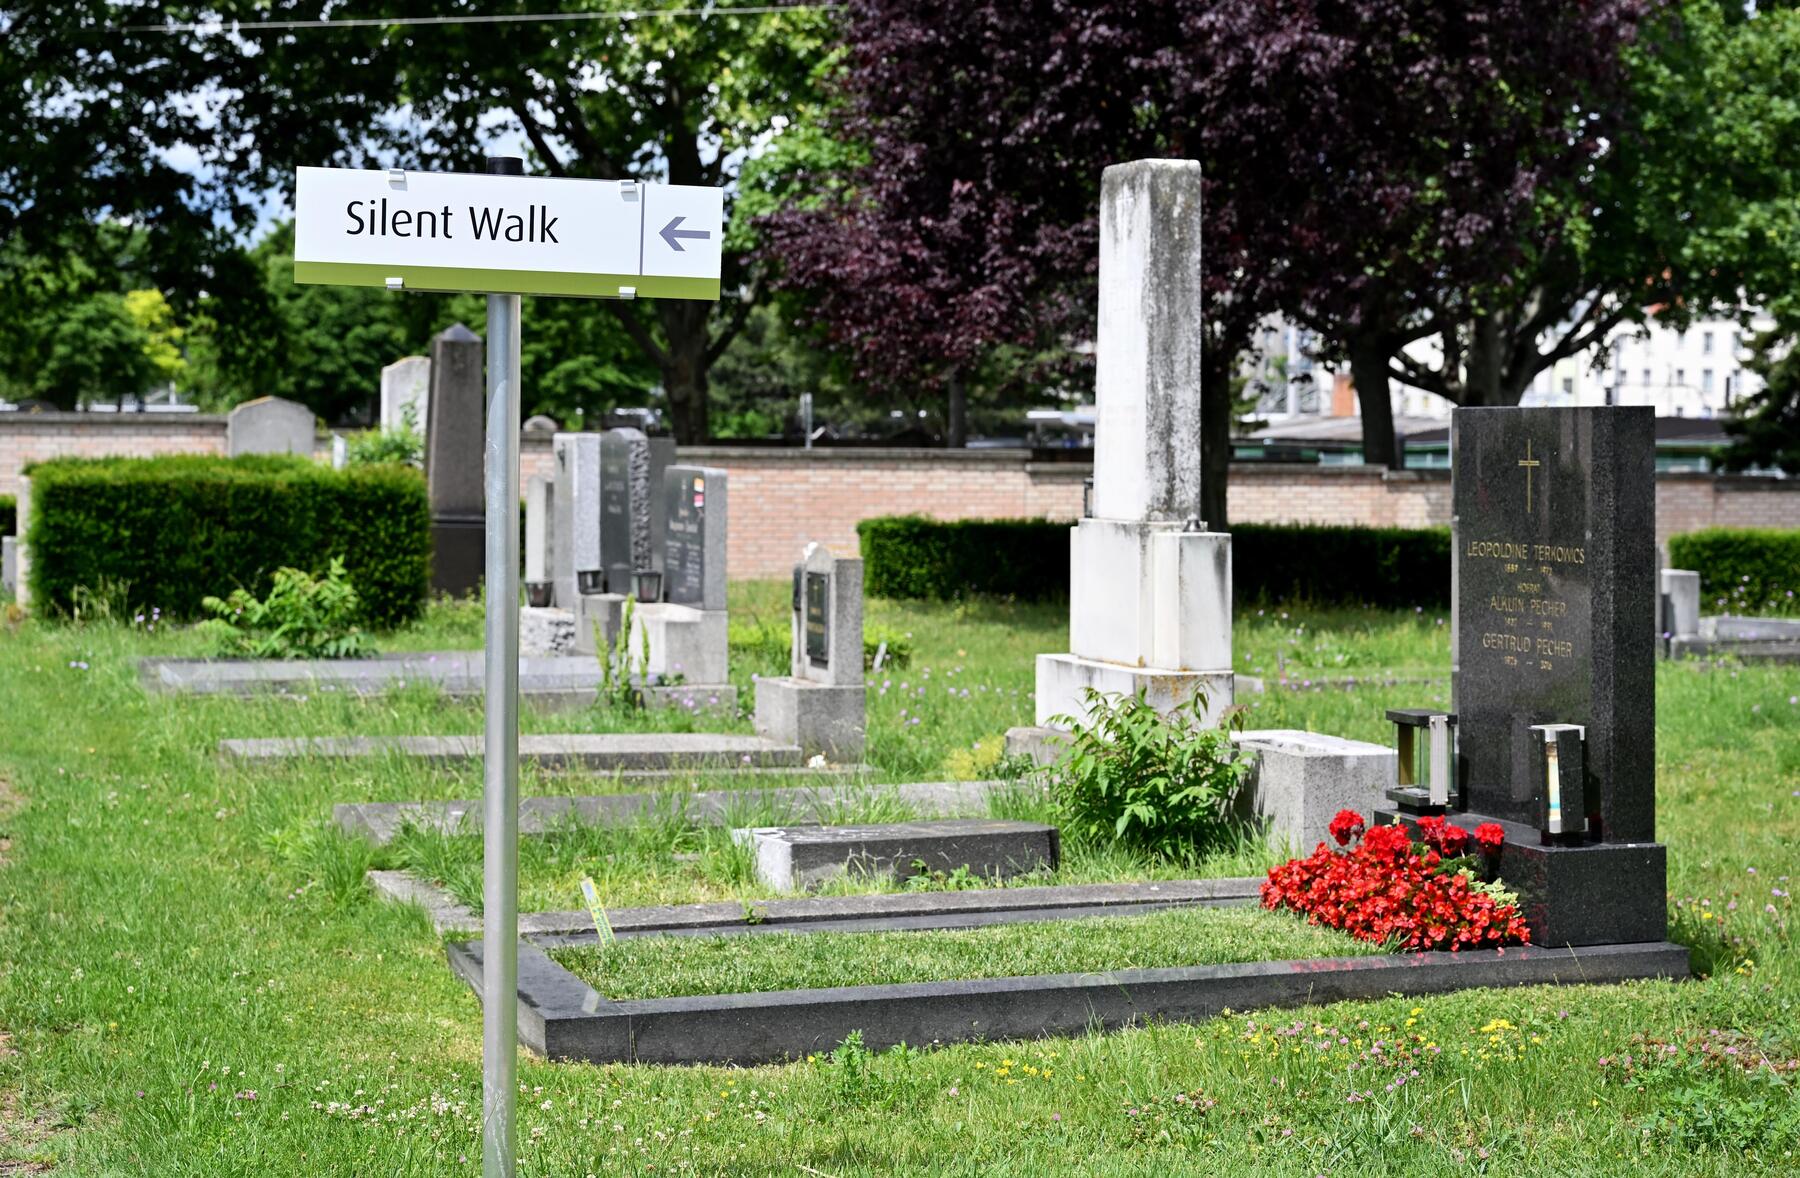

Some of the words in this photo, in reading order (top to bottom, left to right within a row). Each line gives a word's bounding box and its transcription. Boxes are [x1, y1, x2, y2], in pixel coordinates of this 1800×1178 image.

[346, 198, 453, 239] Silent
[468, 204, 560, 244] Walk
[1468, 542, 1527, 559] LEOPOLDINE
[1530, 600, 1567, 616] PECHER
[1482, 632, 1531, 653] GERTRUD
[1536, 638, 1573, 658] PECHER
